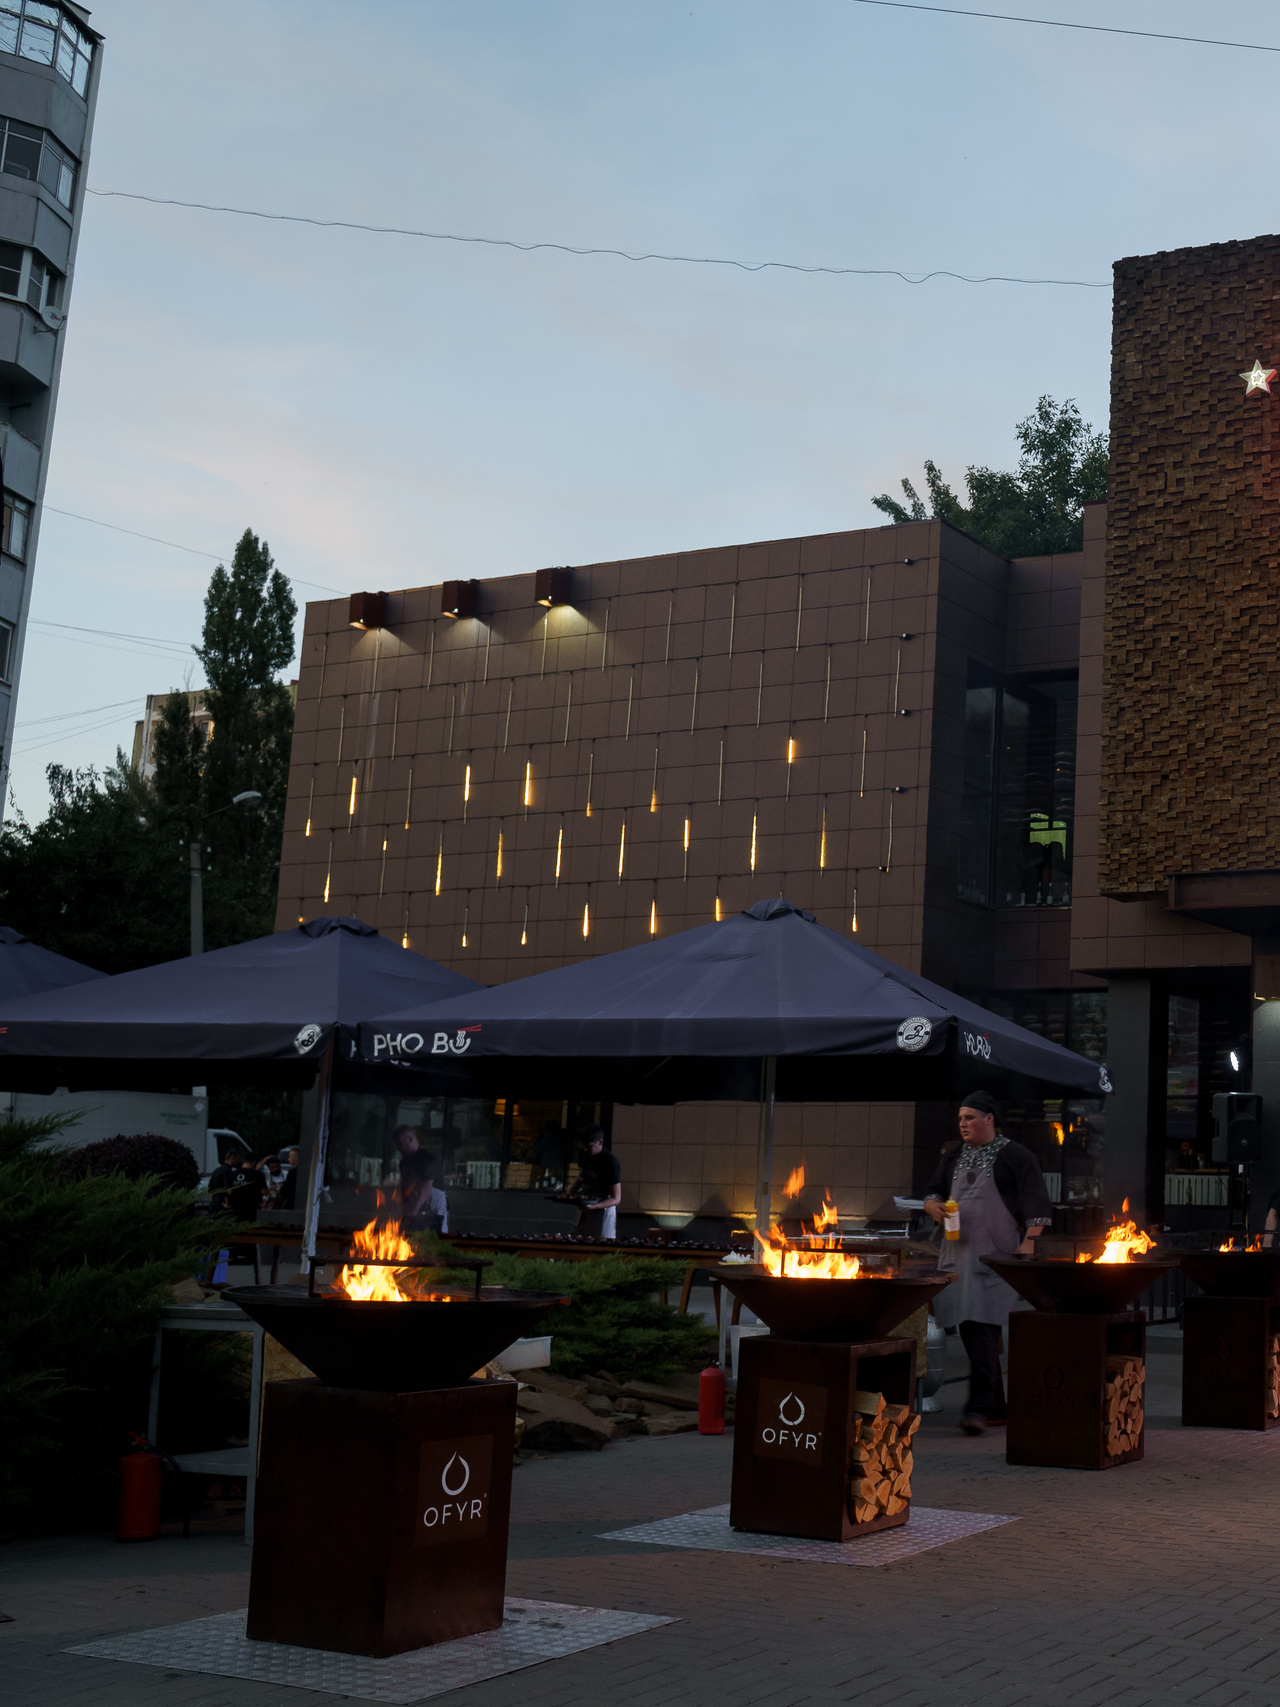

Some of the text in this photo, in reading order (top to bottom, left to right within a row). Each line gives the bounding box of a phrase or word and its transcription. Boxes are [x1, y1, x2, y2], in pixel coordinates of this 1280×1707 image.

[373, 1032, 425, 1057] PHO
[762, 1428, 817, 1450] OFYR
[423, 1499, 482, 1527] OFYR
